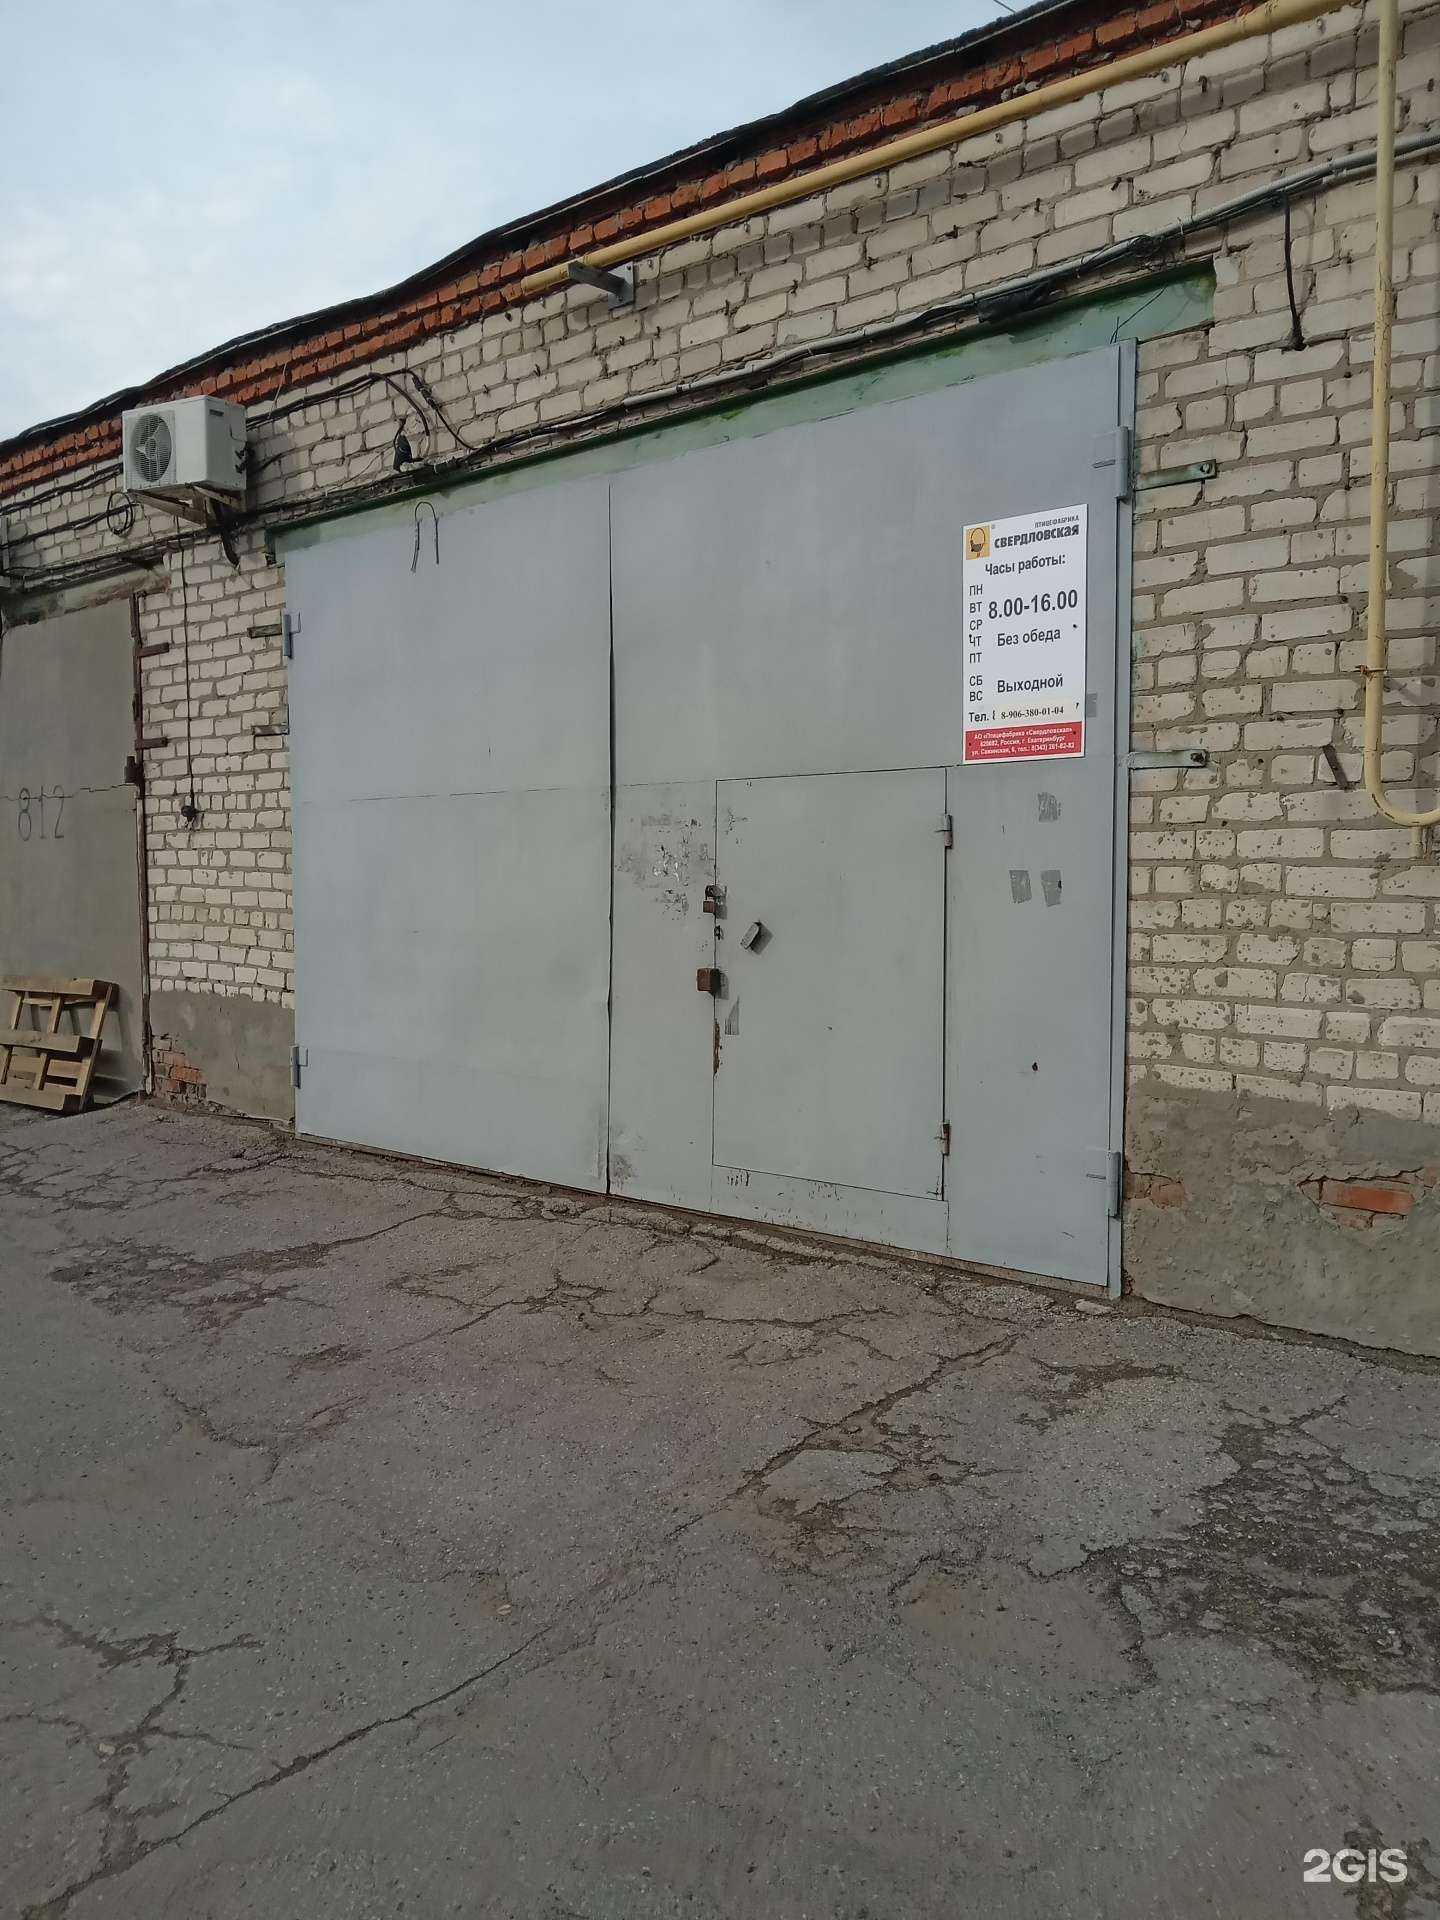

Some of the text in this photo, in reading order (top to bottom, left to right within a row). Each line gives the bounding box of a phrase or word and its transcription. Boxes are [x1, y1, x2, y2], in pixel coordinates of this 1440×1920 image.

[1034, 515, 1080, 528] ПТИЦЕФАБРИКА
[985, 554, 1066, 576] Часы работы:
[969, 584, 983, 596] ПН
[969, 602, 983, 614] ВТ
[988, 589, 1078, 619] 8.00-16.00
[969, 619, 983, 631] СР
[969, 635, 983, 647] ЧТ
[997, 628, 1061, 647] Без обеда
[969, 652, 983, 664] ПТ
[969, 675, 983, 687] СБ
[997, 673, 1064, 693] Выходной
[969, 690, 983, 702] ВС
[968, 712, 989, 723] Тел.
[1001, 706, 1065, 720] 8-906-380-01-04
[18, 784, 65, 841] 812
